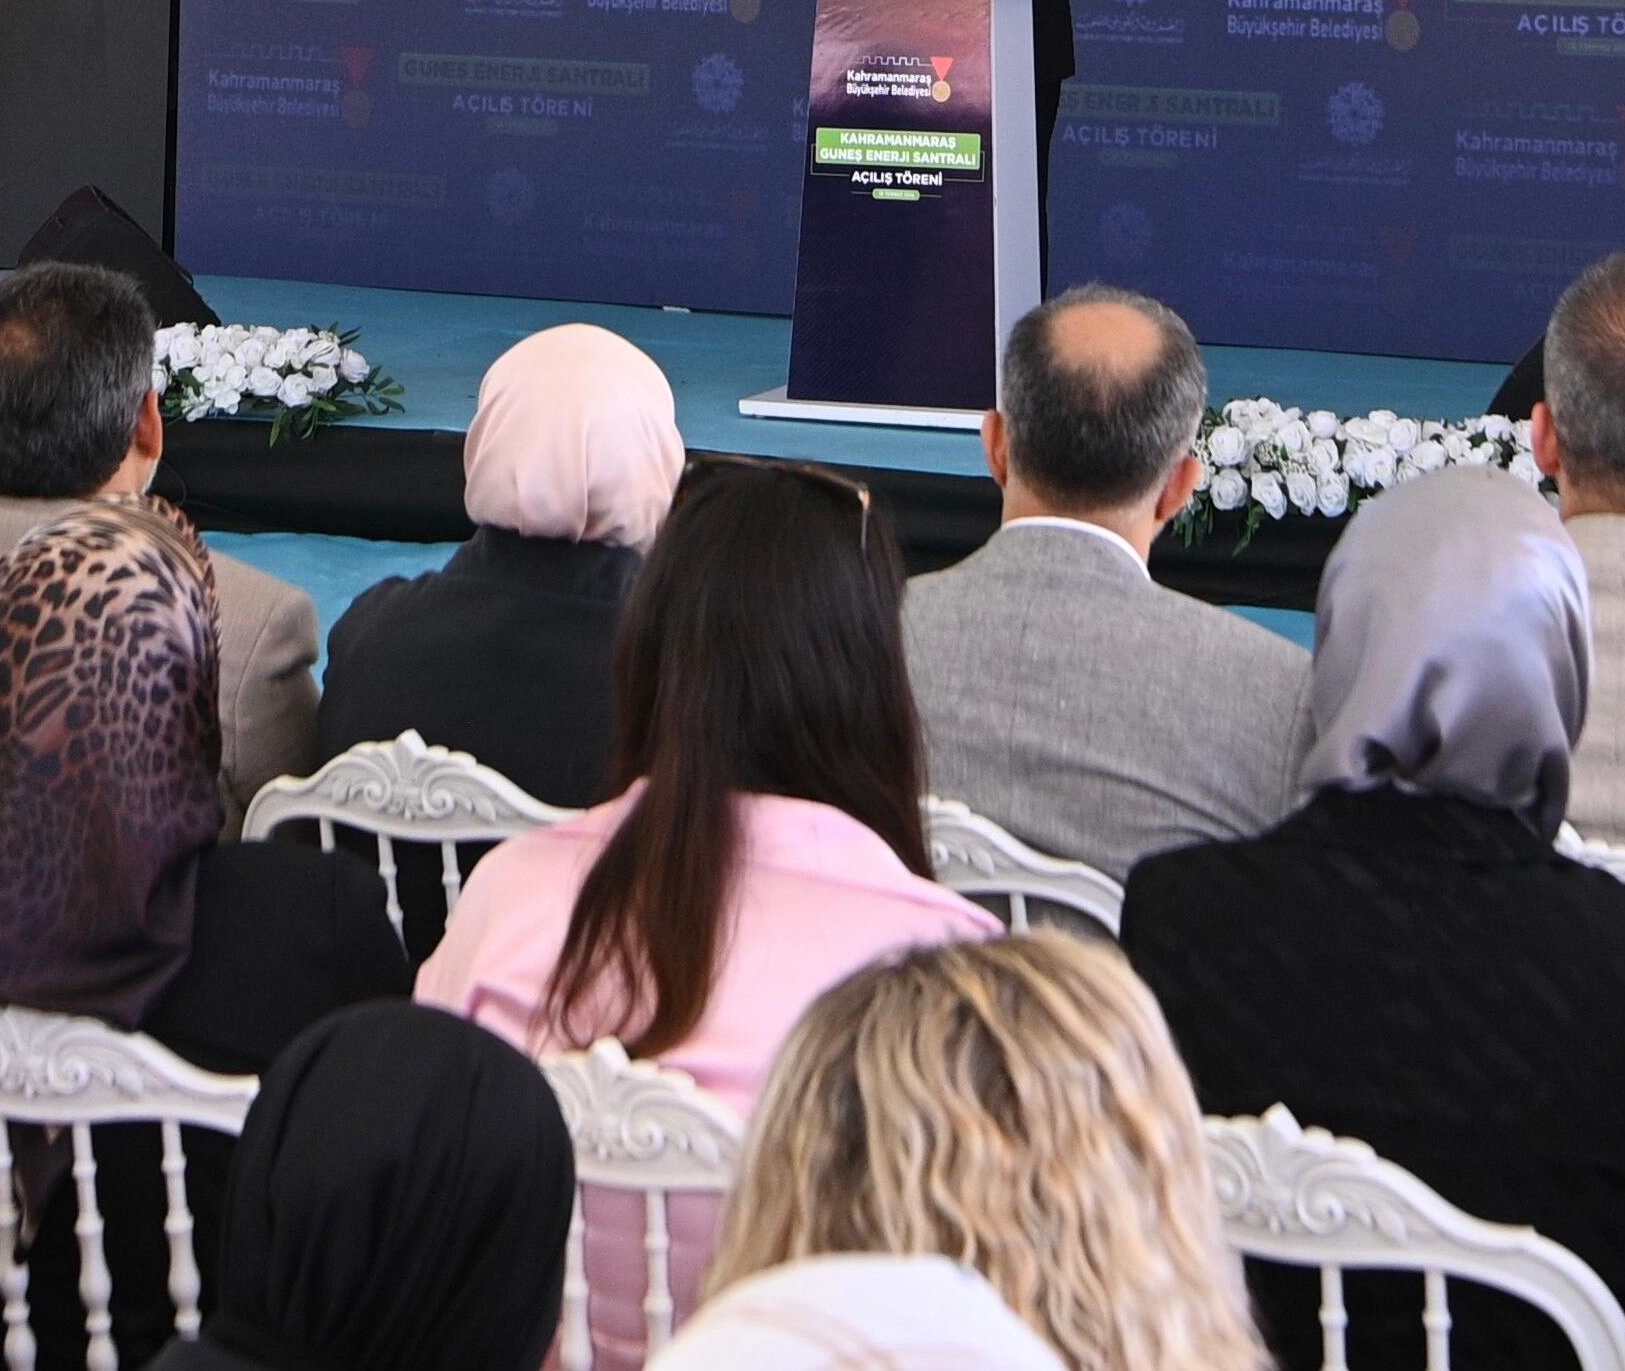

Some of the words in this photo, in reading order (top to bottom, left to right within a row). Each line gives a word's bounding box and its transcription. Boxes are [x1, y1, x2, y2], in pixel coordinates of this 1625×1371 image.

[846, 69, 932, 86] Kahramanmaraş
[891, 84, 932, 99] Belediyesi
[840, 132, 956, 150] KAHRAMANMARAŞ
[1456, 129, 1618, 158] Kahramanmaraş
[852, 170, 892, 186] AÇILIŞ
[895, 170, 943, 187] TÖRENİ
